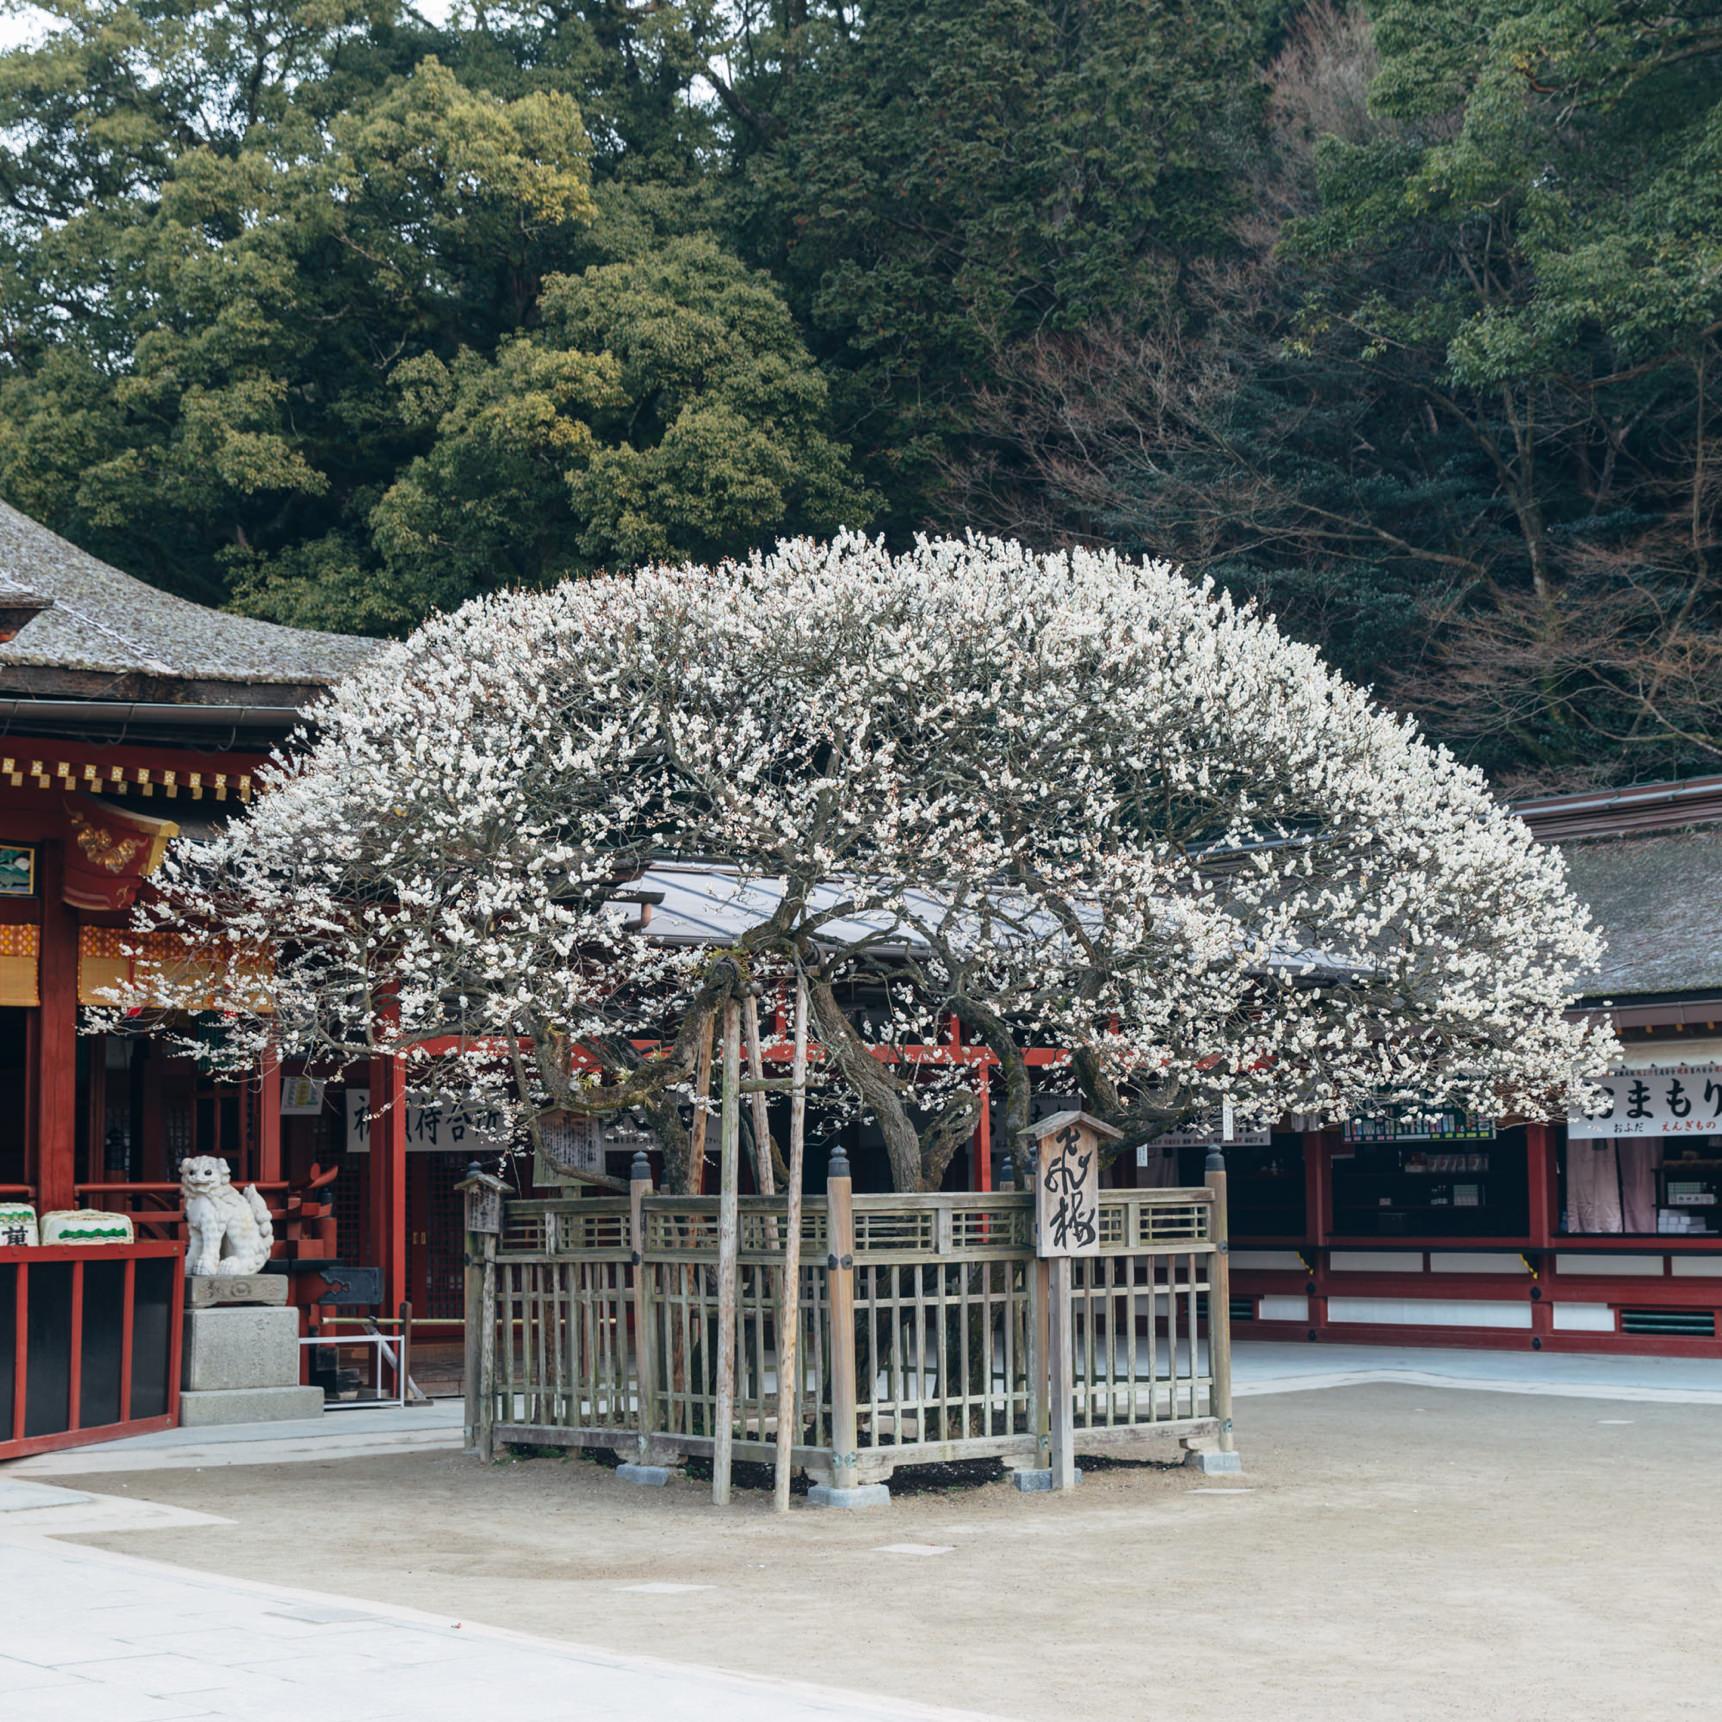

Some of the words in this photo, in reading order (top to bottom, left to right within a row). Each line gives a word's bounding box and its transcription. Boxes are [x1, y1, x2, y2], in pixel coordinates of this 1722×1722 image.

[1614, 1122, 1644, 1133] おふだ
[1661, 1120, 1716, 1132] えんぎもの
